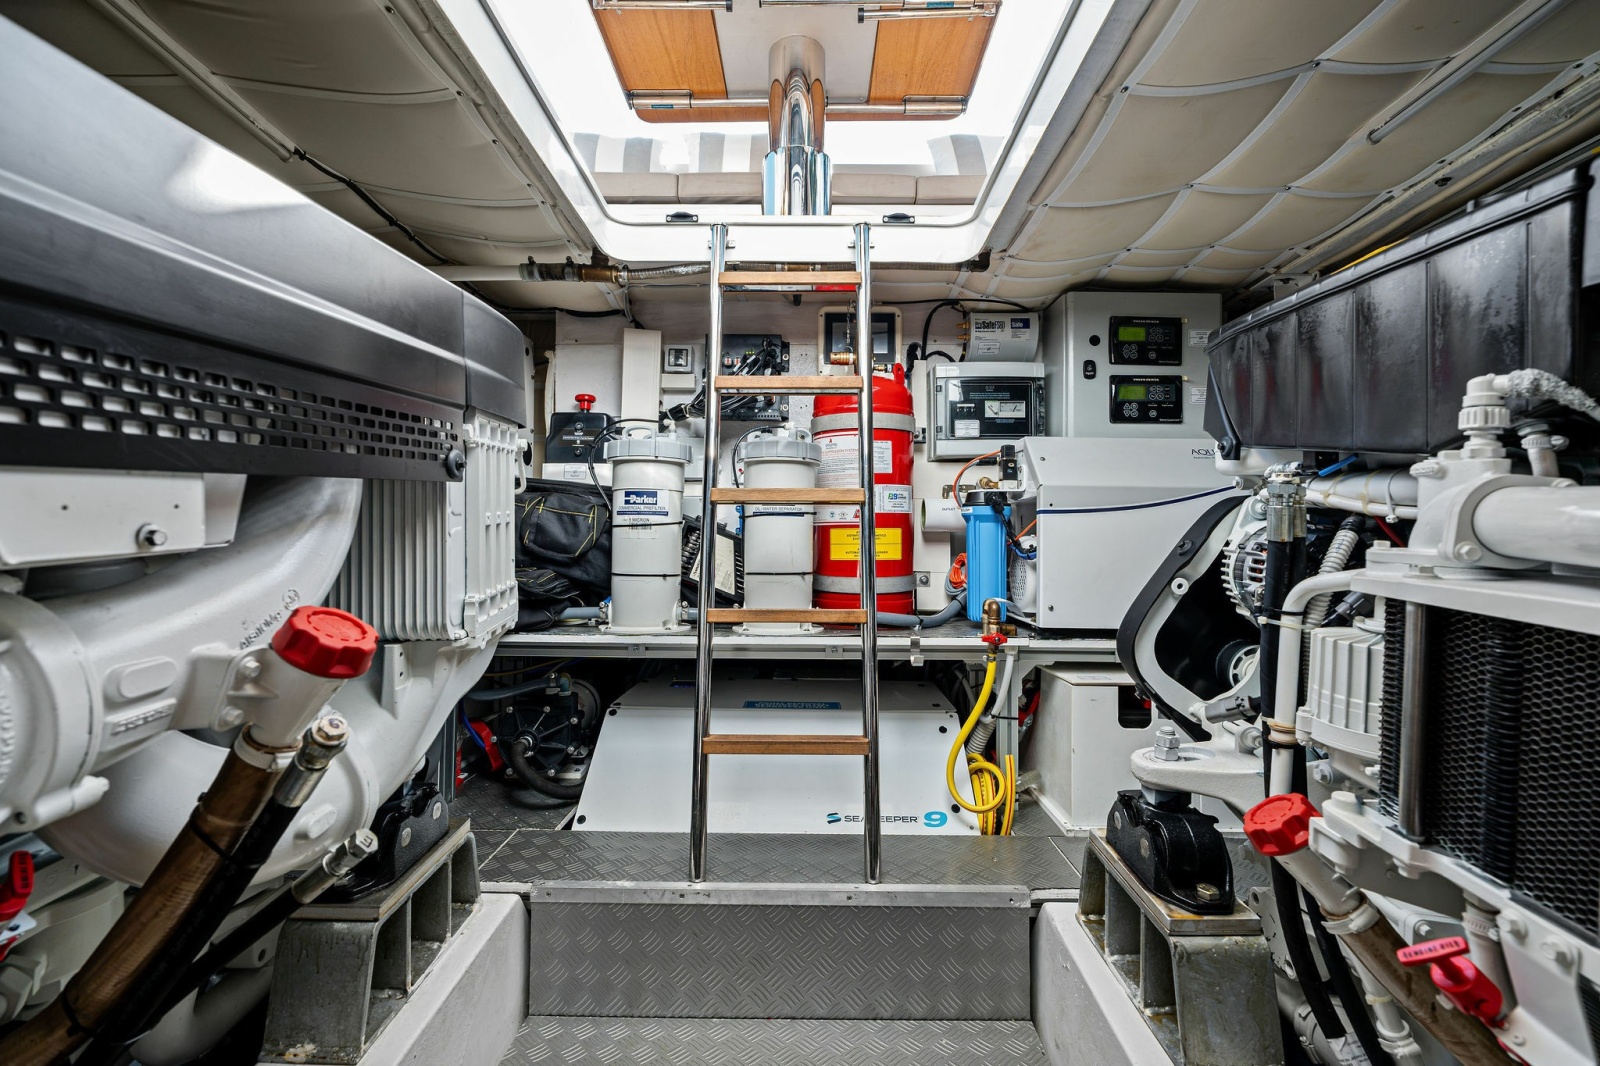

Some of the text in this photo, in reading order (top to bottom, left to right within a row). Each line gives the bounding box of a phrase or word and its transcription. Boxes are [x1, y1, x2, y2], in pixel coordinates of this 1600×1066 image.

[1191, 448, 1215, 456] AQU
[629, 494, 657, 503] Parker
[844, 810, 949, 828] SEEEPER 9
